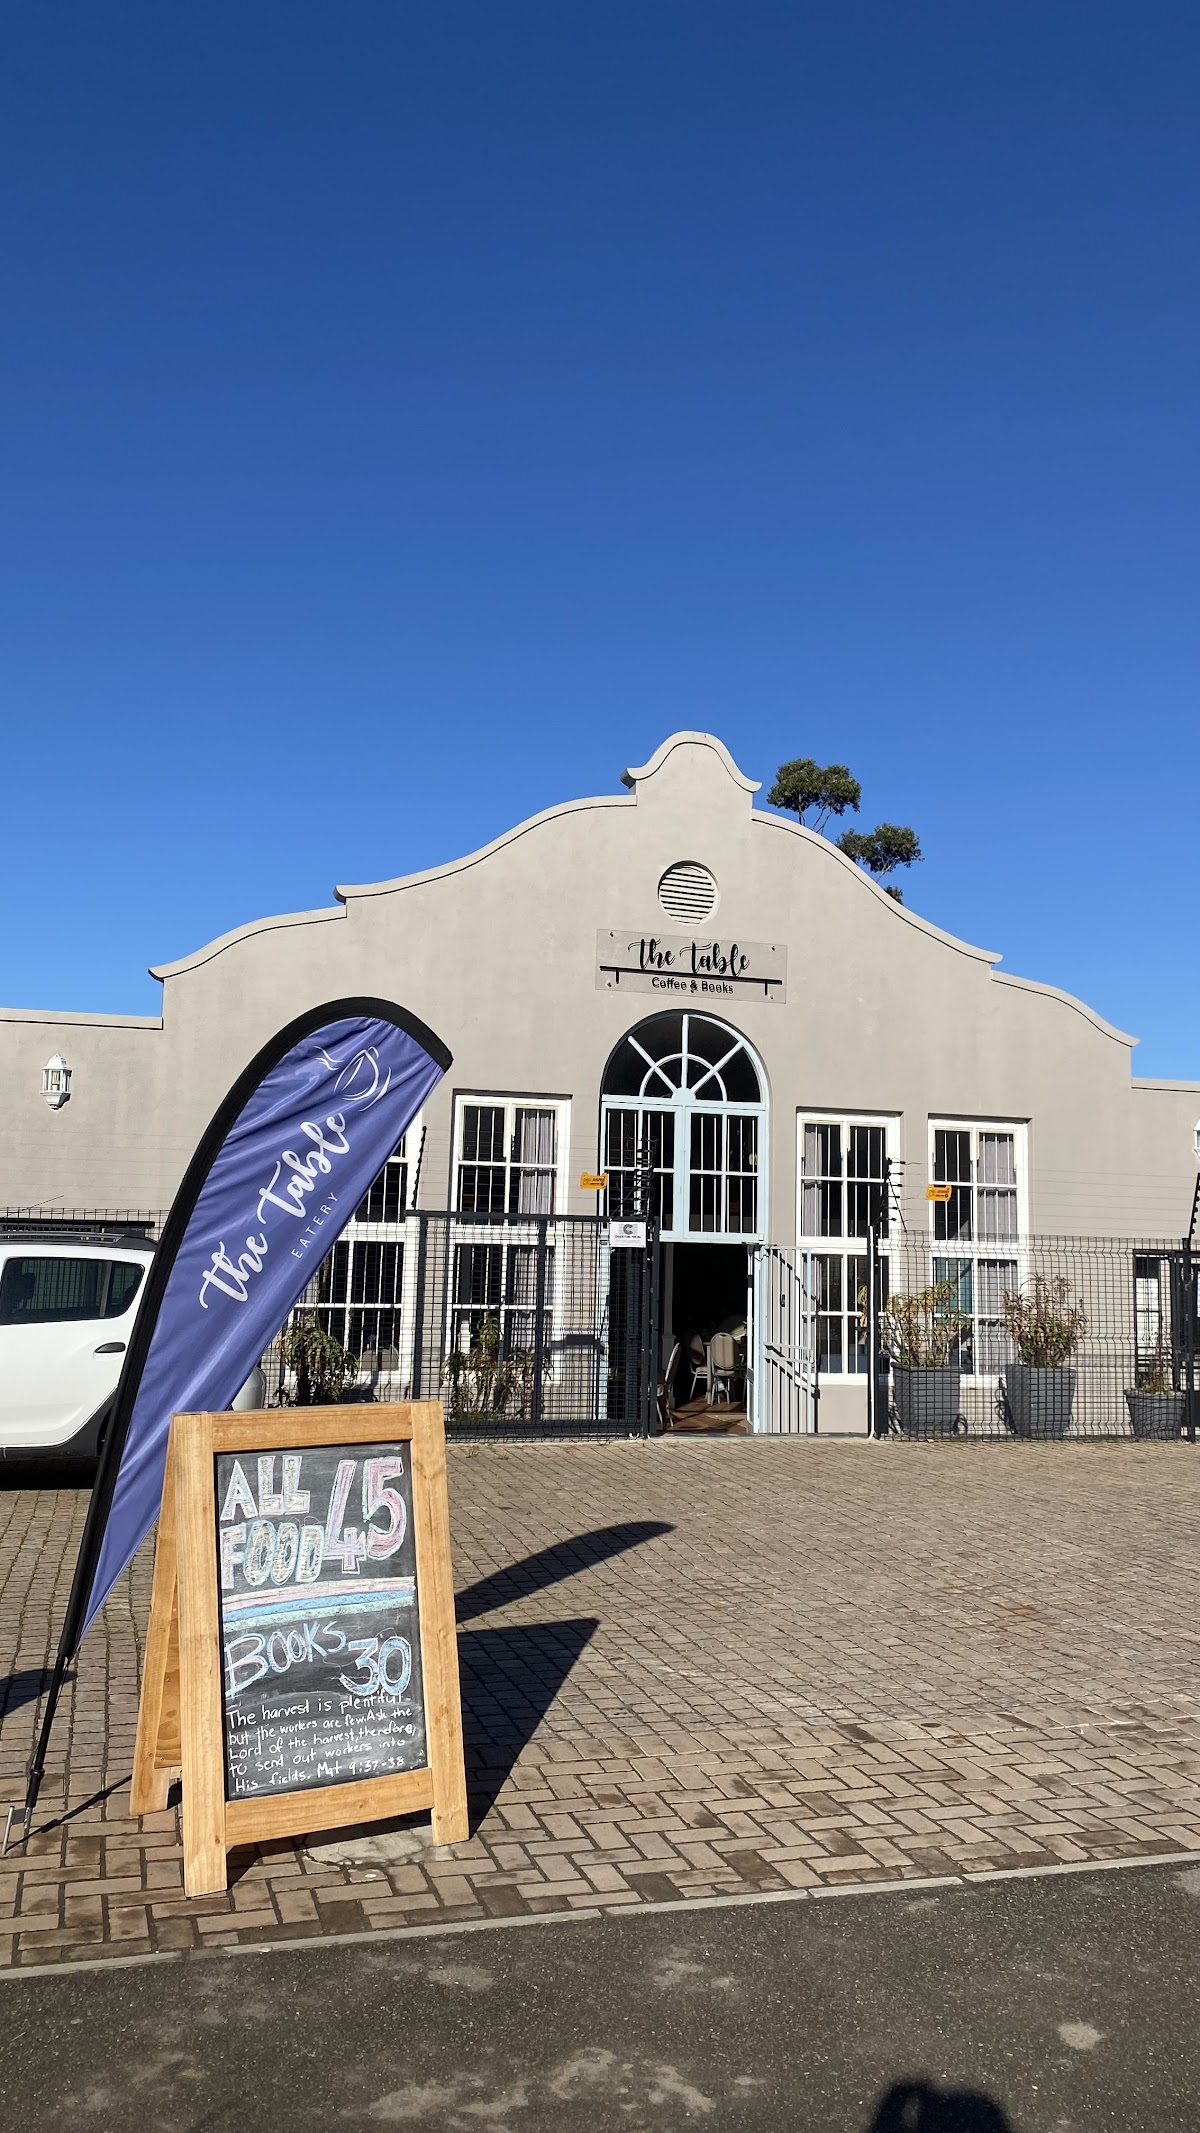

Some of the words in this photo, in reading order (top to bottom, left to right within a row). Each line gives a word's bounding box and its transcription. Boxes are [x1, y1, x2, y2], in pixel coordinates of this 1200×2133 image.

[628, 938, 676, 970] the
[651, 976, 687, 991] Coffee
[689, 979, 698, 994] &
[701, 980, 734, 994] Books
[291, 1192, 338, 1259] EATERY
[199, 1233, 268, 1309] the
[220, 1455, 311, 1521] ALL
[321, 1455, 407, 1575] 45
[220, 1519, 325, 1589] FOOD
[224, 1620, 347, 1699] BOOKS
[338, 1635, 412, 1696] 30
[226, 1709, 257, 1729] The
[261, 1699, 310, 1720] harvest
[317, 1698, 332, 1712] is
[339, 1688, 402, 1715] plentiful
[229, 1731, 250, 1745] but
[255, 1726, 276, 1741] the
[279, 1719, 318, 1734] workers
[322, 1719, 342, 1729] are
[391, 1707, 412, 1718] the
[229, 1742, 262, 1760] Lord
[269, 1736, 283, 1754] of
[287, 1736, 308, 1749] the
[229, 1762, 247, 1778] to
[255, 1754, 284, 1771] send
[292, 1747, 317, 1765] out
[325, 1740, 373, 1758] workers
[379, 1737, 406, 1749] into
[235, 1778, 259, 1792] His
[269, 1767, 311, 1786] fields.
[317, 1760, 342, 1778] Mat
